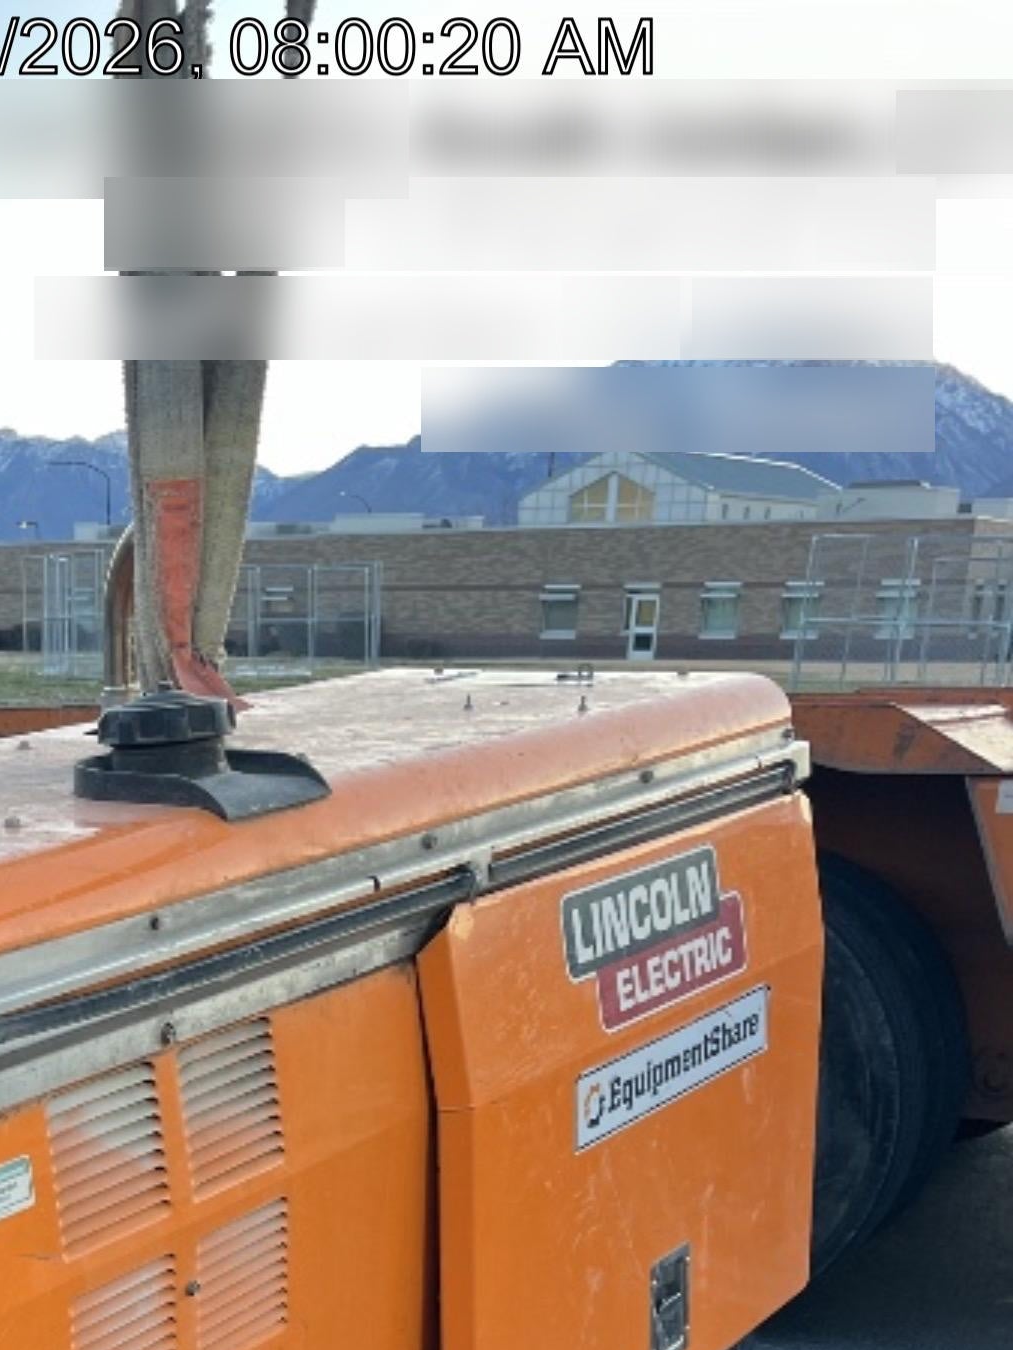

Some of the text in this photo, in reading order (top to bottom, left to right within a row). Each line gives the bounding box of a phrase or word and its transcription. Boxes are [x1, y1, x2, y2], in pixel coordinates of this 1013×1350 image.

[571, 860, 713, 965] LINCOLN
[615, 925, 734, 1013] ELECTRIC
[607, 1012, 760, 1112] EquipmentShare
